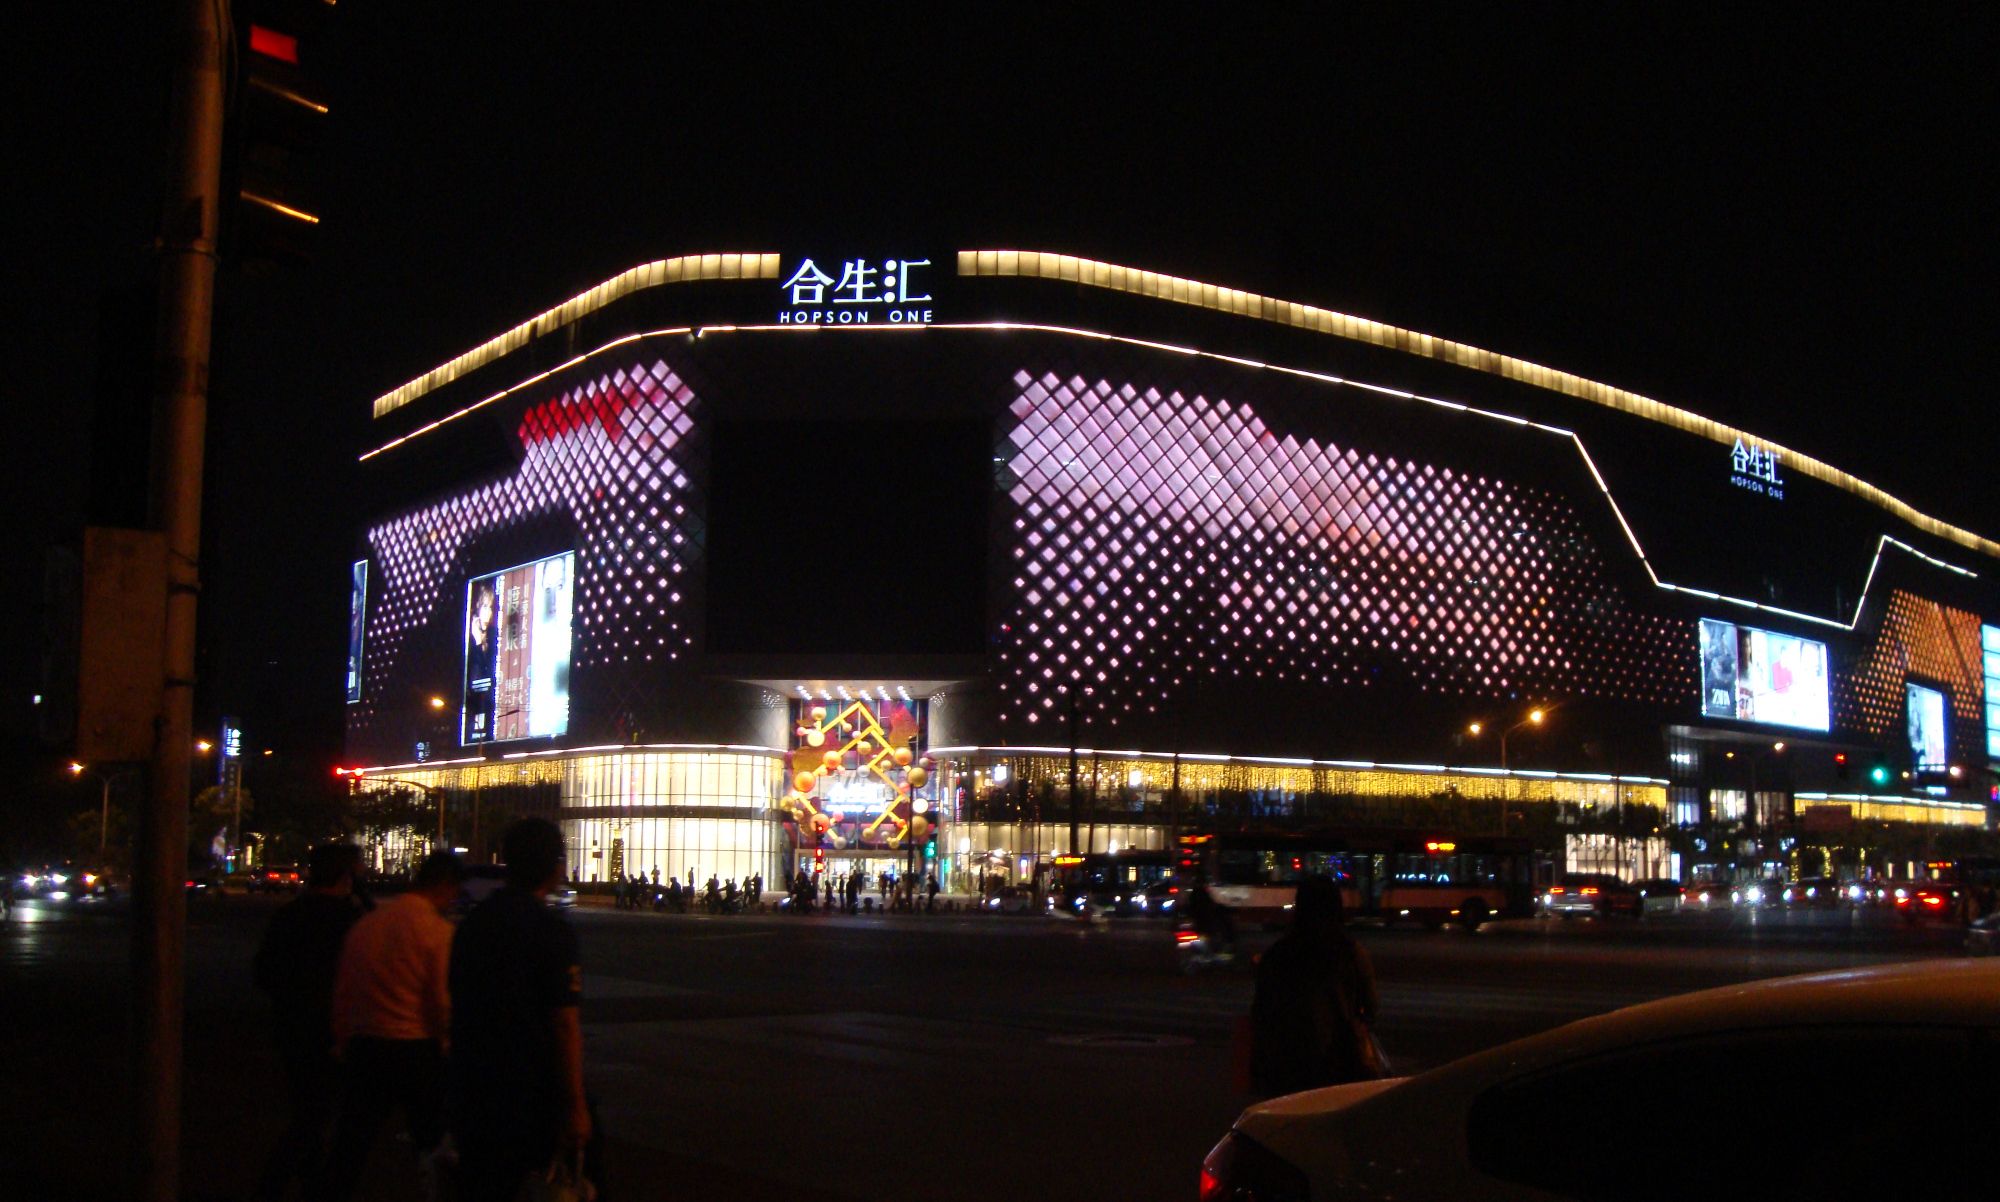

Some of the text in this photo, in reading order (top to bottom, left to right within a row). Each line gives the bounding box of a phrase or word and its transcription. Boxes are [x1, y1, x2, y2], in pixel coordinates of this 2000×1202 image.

[781, 258, 933, 305] 合生汇
[780, 310, 933, 324] HOPSON ONE
[1730, 437, 1783, 485] 合生汇
[1731, 476, 1784, 501] HOPSON ONE
